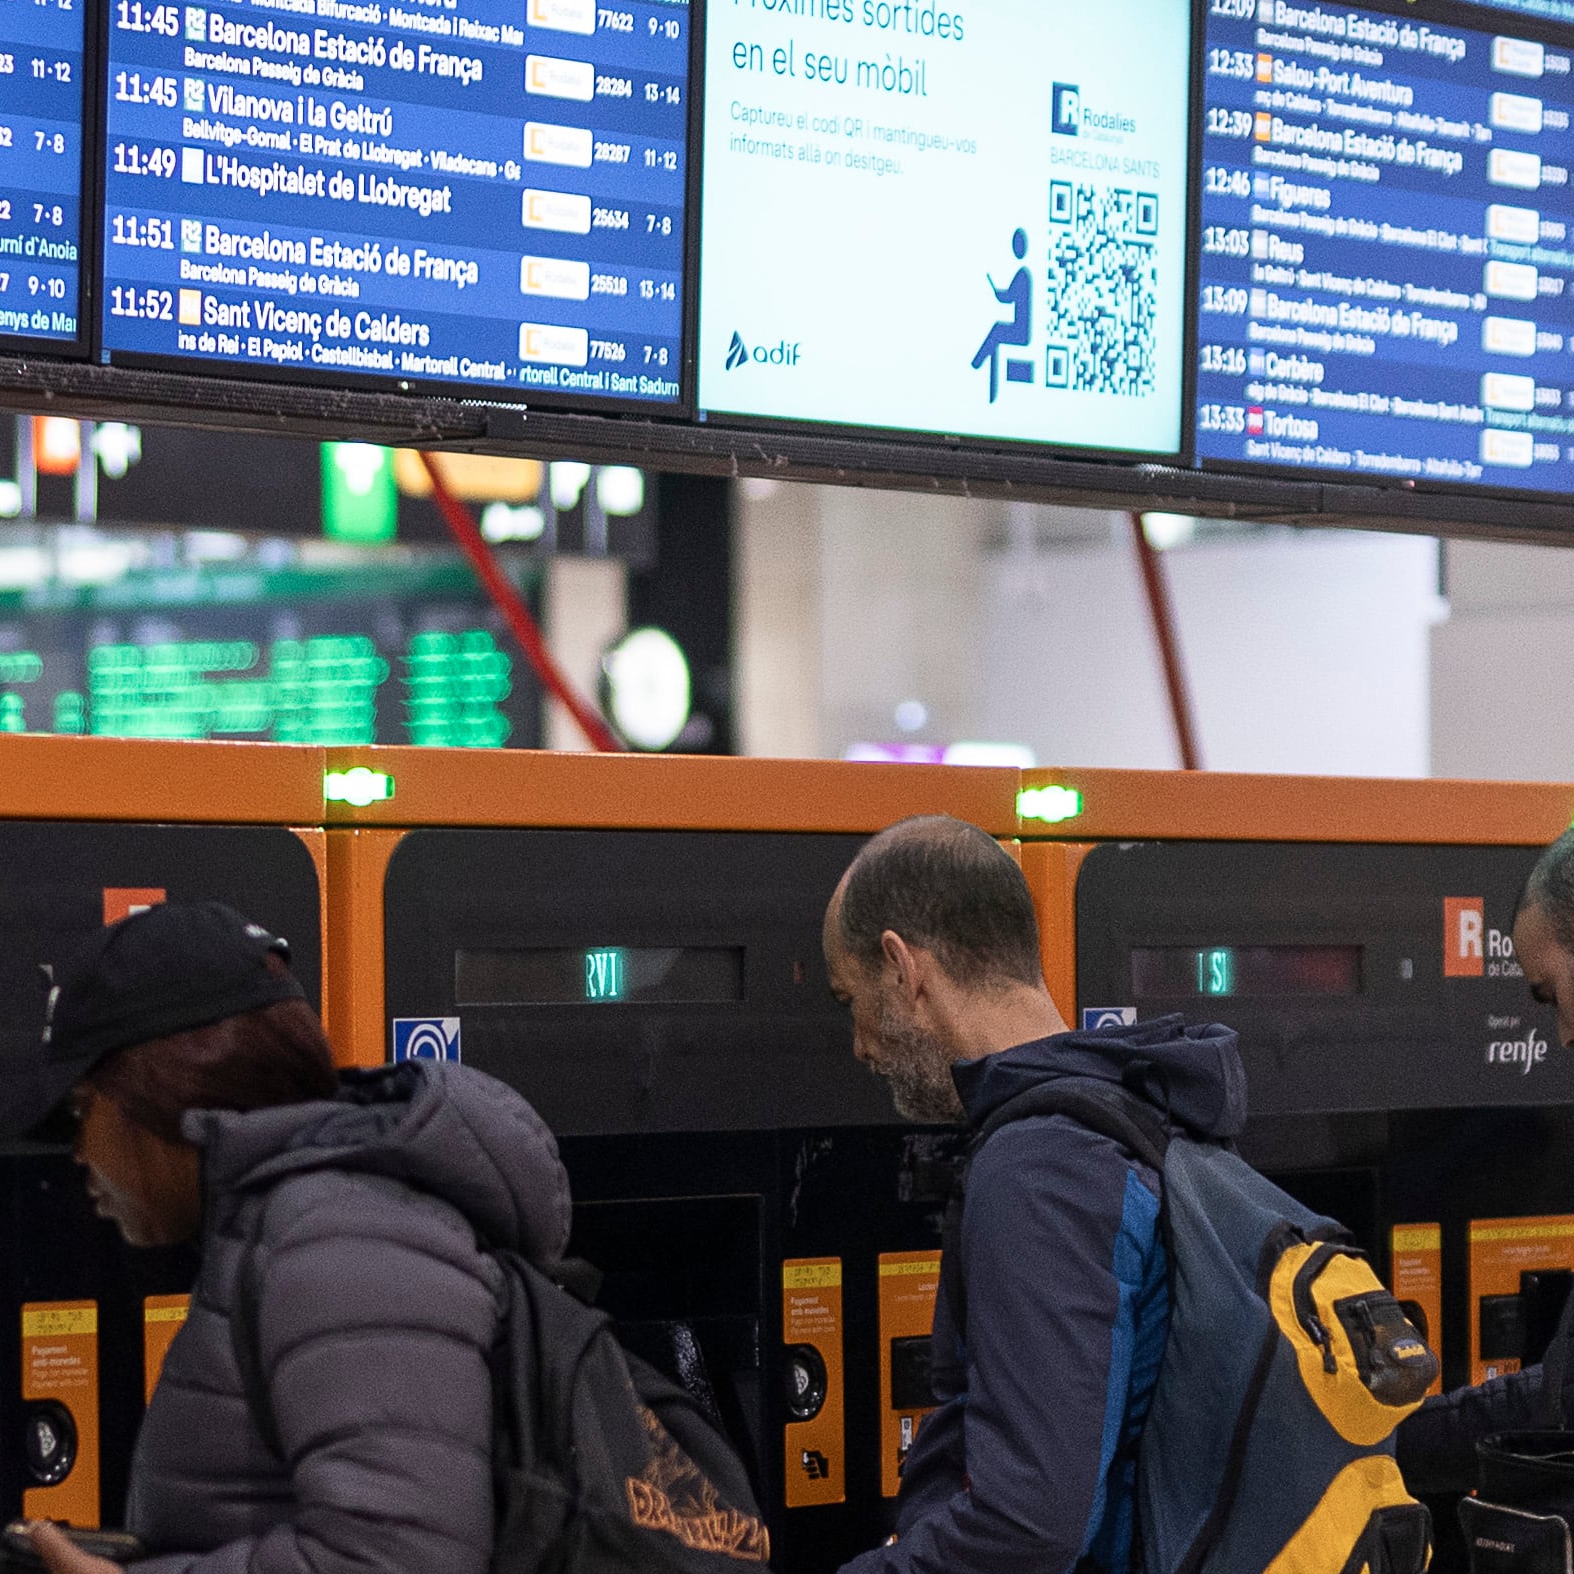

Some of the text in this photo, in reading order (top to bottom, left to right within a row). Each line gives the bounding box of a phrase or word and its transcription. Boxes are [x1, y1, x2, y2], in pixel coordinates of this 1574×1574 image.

[389, 7, 451, 35] Montcada
[453, 17, 458, 36] i
[459, 19, 500, 42] Reixac
[863, 0, 964, 41] sortides
[117, 1, 482, 86] 11:45 Barcelona Estació de França
[185, 47, 363, 91] Barcelona Passeig de Gràcia
[733, 39, 927, 96] en el seu mòbil
[115, 72, 392, 138] 11:45 Vilanova i la Geltrú
[1083, 107, 1136, 133] Rodalies
[730, 100, 792, 127] Captureu
[796, 111, 809, 130] el
[812, 114, 840, 136] codi
[844, 116, 863, 138] QR
[873, 124, 977, 155] mantingueu-vos
[730, 132, 794, 160] informats
[798, 143, 821, 164] allà
[825, 149, 842, 166] on
[1272, 118, 1342, 153] Barcelona
[1344, 129, 1395, 161] Estació
[1397, 138, 1414, 163] de
[1416, 142, 1462, 176] França
[300, 132, 312, 153] El
[315, 135, 341, 157] Prat
[343, 139, 360, 159] de
[362, 142, 423, 170] Llobregat
[1049, 146, 1161, 179] BARCELONA SANTS
[114, 143, 451, 216] 11:49 L'Hospitalet de Llobregat
[113, 214, 479, 289] 11:51 Barcelona Estació de França
[180, 259, 360, 298] Barcelona Passeig de Gràcia
[31, 309, 49, 330] de
[111, 286, 430, 347] 11:52 Sant Vicenç de Calders
[199, 332, 216, 353] de
[218, 336, 239, 356] Rei
[248, 337, 261, 357] El
[263, 339, 303, 363] Papiol
[311, 342, 394, 370] Castellbisbal
[401, 352, 458, 376] Martorell
[459, 357, 506, 380] Central
[753, 341, 801, 367] adif
[559, 368, 604, 390] Central
[605, 371, 610, 390] i
[611, 373, 638, 393] Sant
[1265, 410, 1318, 442] Tortosa
[1459, 909, 1483, 957] R
[1489, 1028, 1547, 1075] renfe
